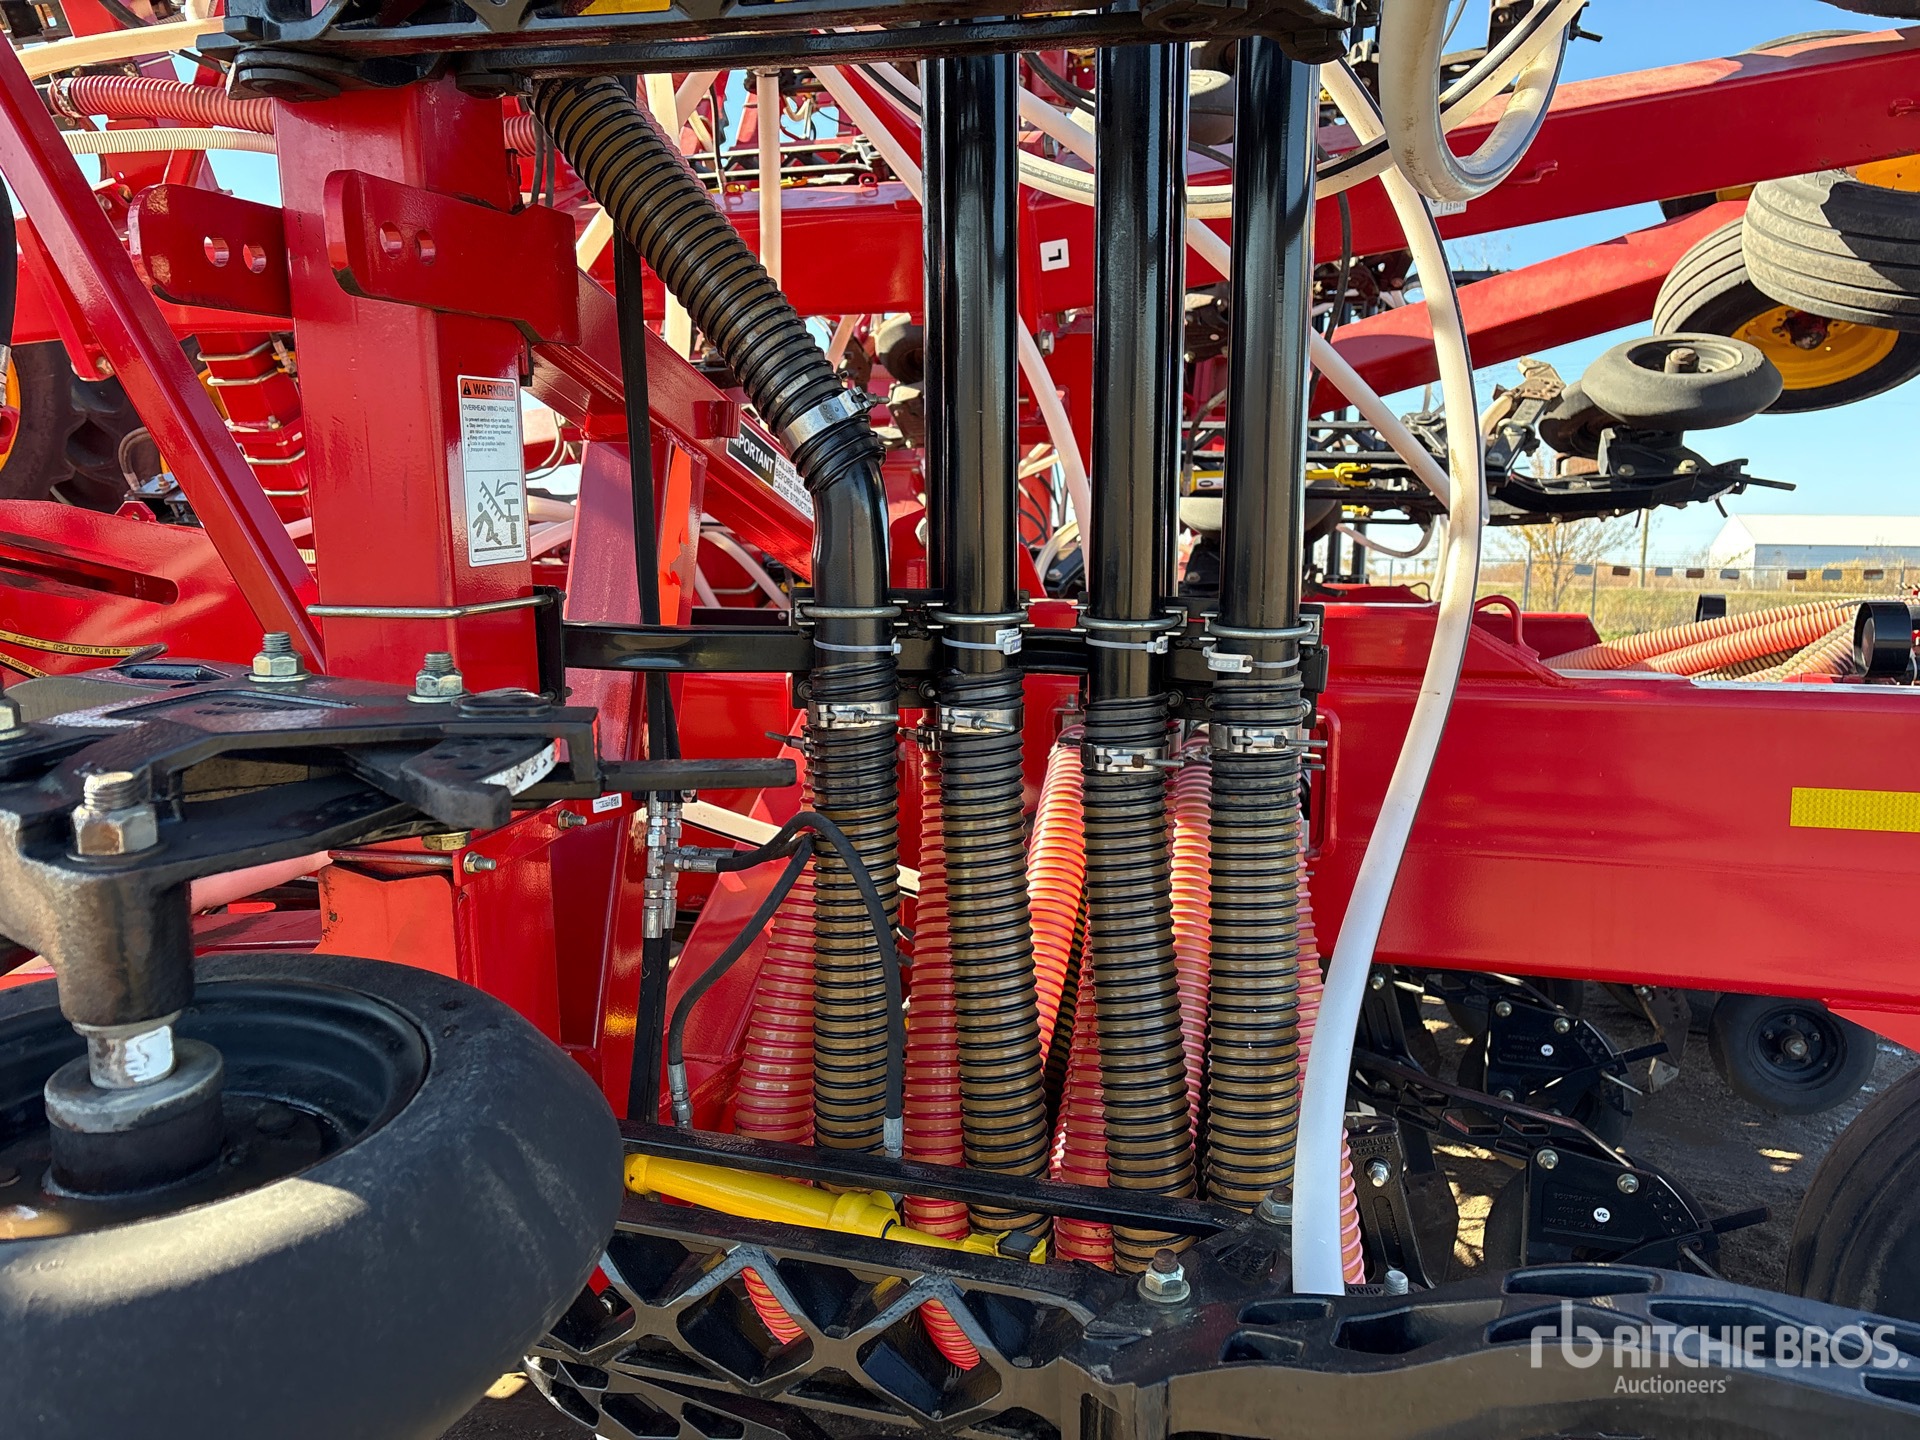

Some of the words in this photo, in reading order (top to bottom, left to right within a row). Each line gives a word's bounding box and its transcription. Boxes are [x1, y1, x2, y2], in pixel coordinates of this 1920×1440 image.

[1048, 248, 1062, 262] L
[473, 383, 513, 397] WARNING
[776, 456, 794, 478] FAILURE
[776, 468, 793, 488] BEFORE
